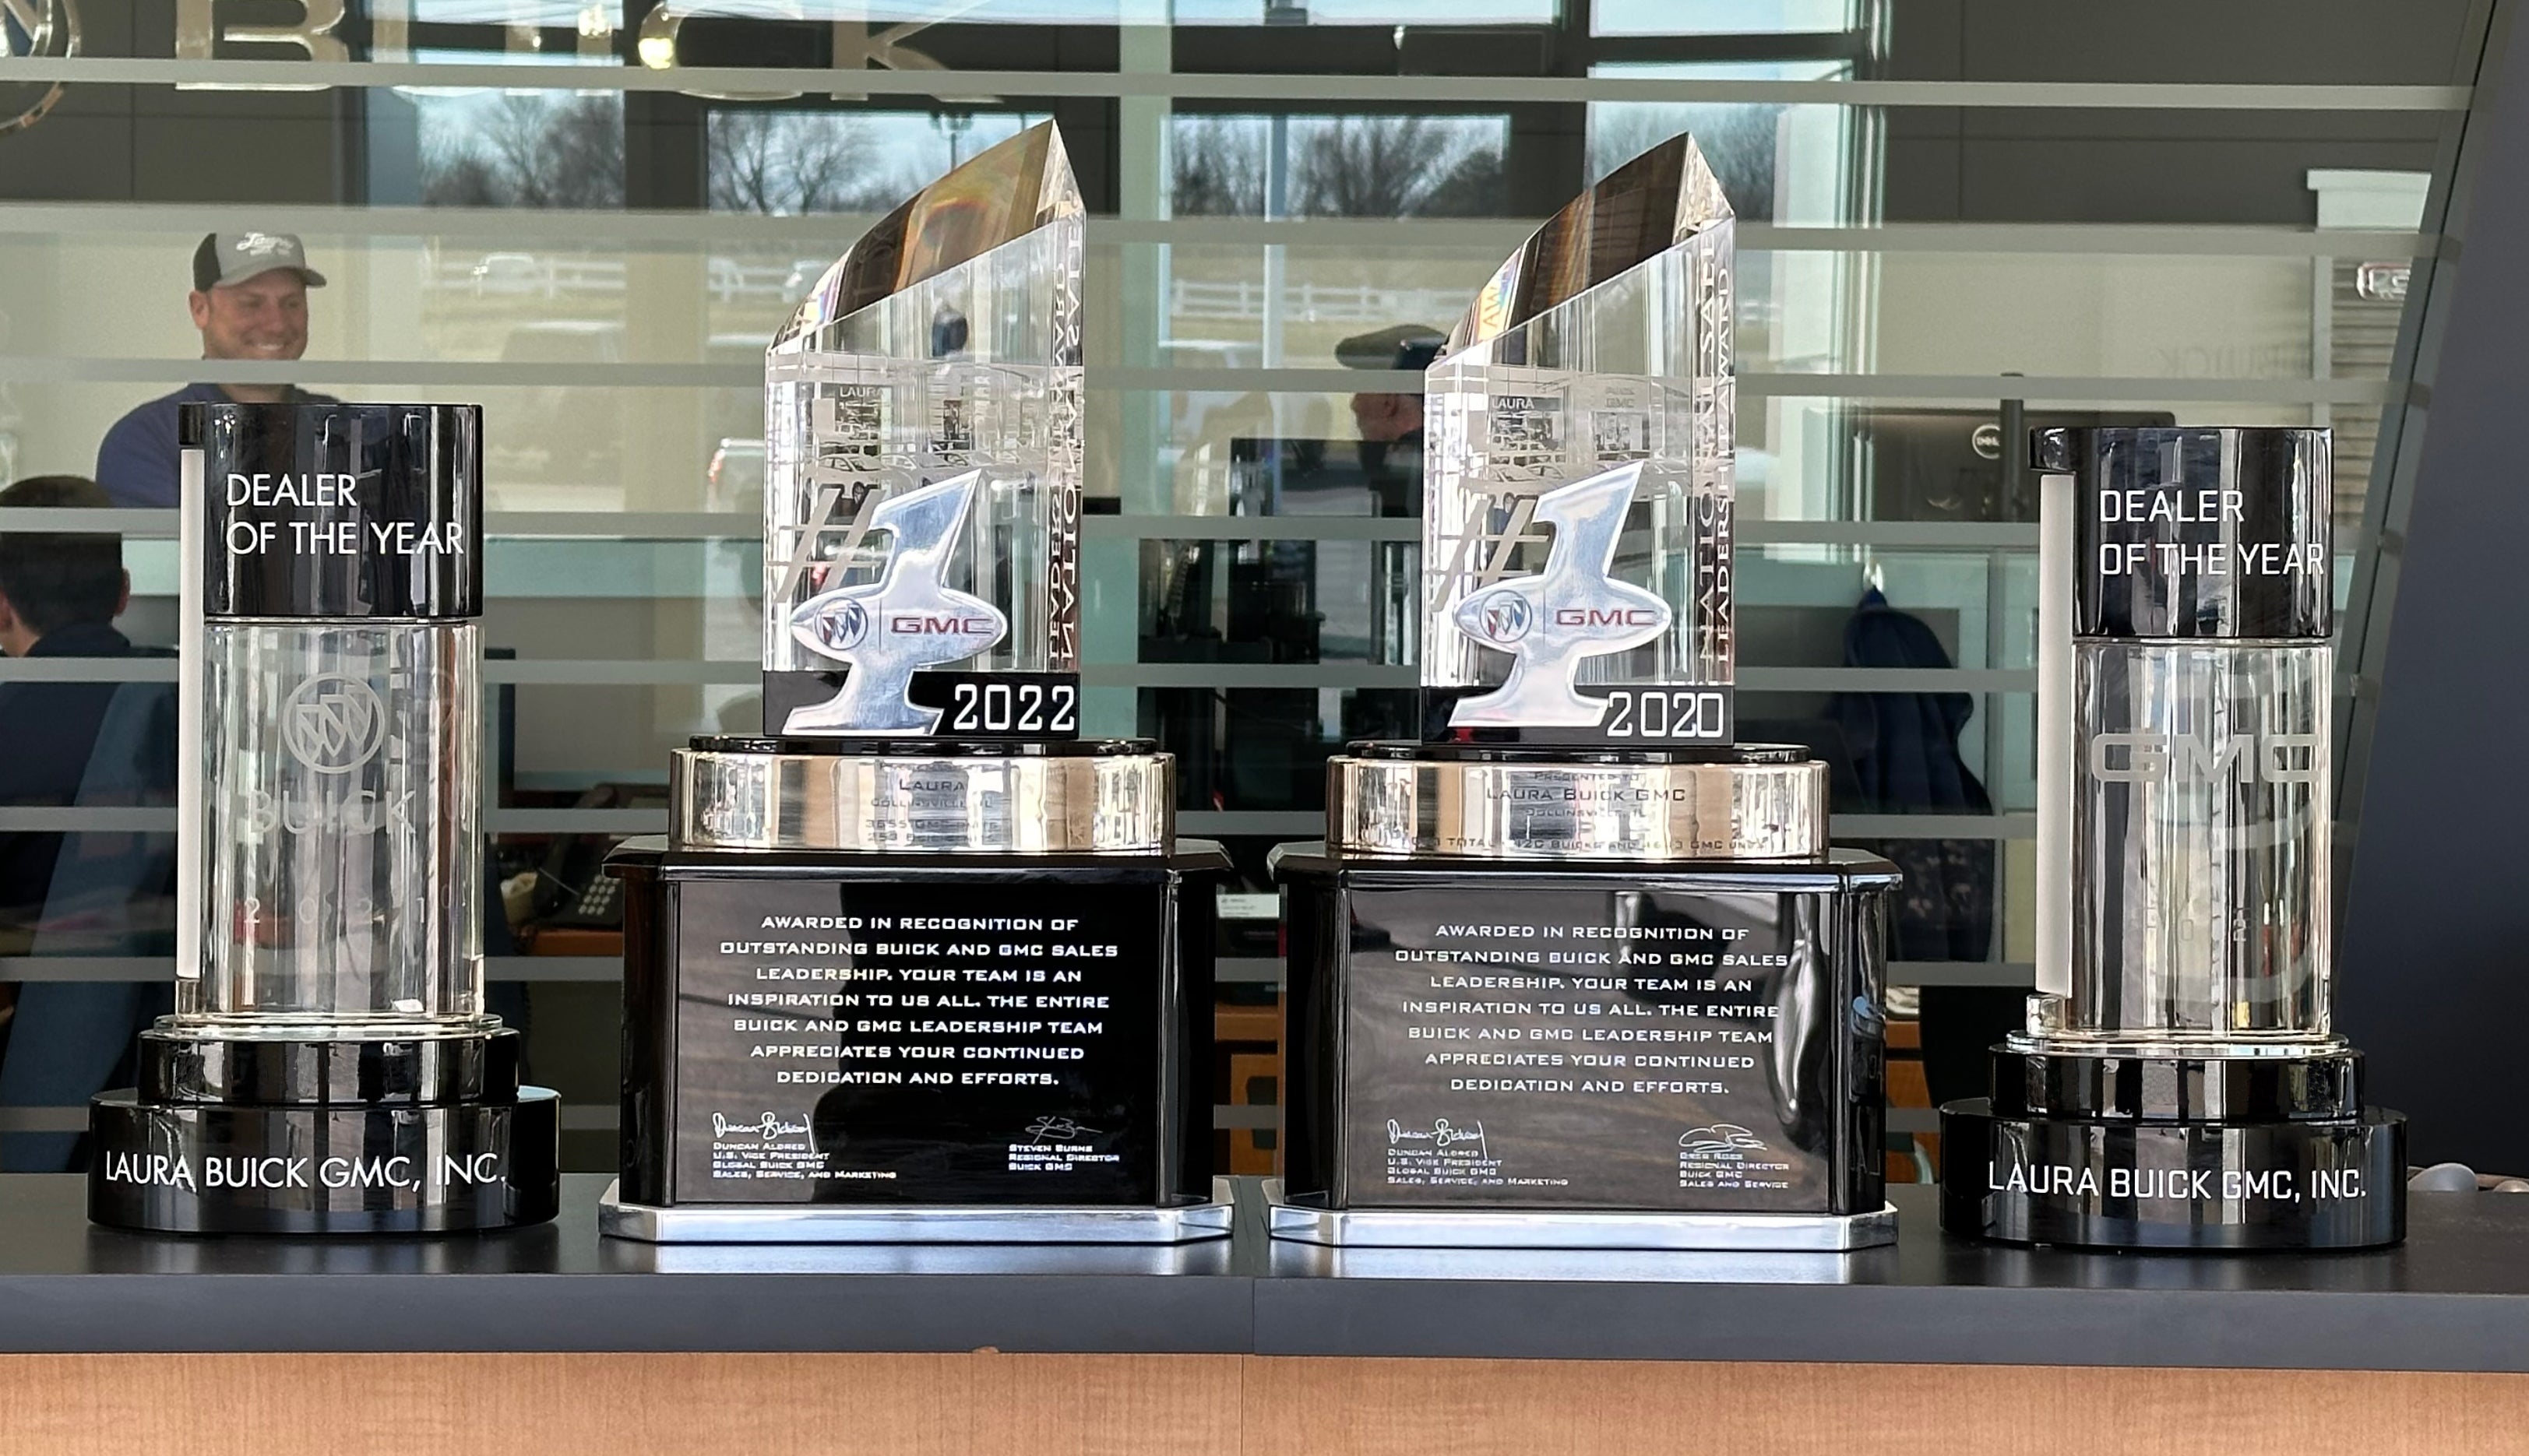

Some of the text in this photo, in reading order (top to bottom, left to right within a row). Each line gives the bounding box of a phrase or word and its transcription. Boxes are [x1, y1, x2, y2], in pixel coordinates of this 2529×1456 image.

[1492, 398, 1534, 410] LAURA
[227, 473, 357, 506] DEALER
[2100, 490, 2244, 522] DEALER
[227, 522, 463, 555] OF THE YEAR
[2099, 543, 2324, 575] OF THE YEAR
[1555, 607, 1658, 627] GMC
[891, 615, 998, 636] GMC
[953, 684, 1076, 731] 2022
[1606, 691, 1724, 737] 2020
[2090, 733, 2323, 784] GMC
[900, 779, 965, 791] LAURA
[1487, 788, 1686, 801] LAURA BUICK GMC
[249, 790, 415, 834] BUICK
[1691, 841, 1723, 849] GMC
[762, 916, 1078, 930] AWARDED IN RECOGNITION OF
[1435, 925, 1749, 940] AWARDED IN RECOGNITION OF
[720, 942, 1117, 956] OUTSTANDING BUICK AND GMC SALES
[1396, 950, 1791, 967] OUTSTANDING BUICK AND GMC SALES
[757, 969, 1081, 982] LEADERSHIP. YOUR TEAM IS AN
[1432, 976, 1751, 991] LEADERSHIP. YOUR TEAM IS AN
[728, 994, 1108, 1008] INSPIRATION TO US ALL. THE ENTIRE
[1404, 1001, 1781, 1018] INSPIRATION TO US ALL. THE ENTIRE
[734, 1019, 1102, 1033] BUICK AND GMC LEADERSHIP TEAM
[1409, 1028, 1772, 1043] BUICK AND GMC LEADERSHIP TEAM
[751, 1046, 1083, 1059] APPRECIATES YOUR CONTINUED
[1425, 1053, 1754, 1067] APPRECIATES YOUR CONTINUED
[777, 1071, 1058, 1085] DEDICATION AND EFFORTS.
[1451, 1079, 1729, 1093] DEDICATION AND EFFORTS.
[106, 1151, 506, 1194] LAURA BUICK GMC, INC.
[1988, 1161, 2367, 1205] LAURA BUICK GMC, INC.
